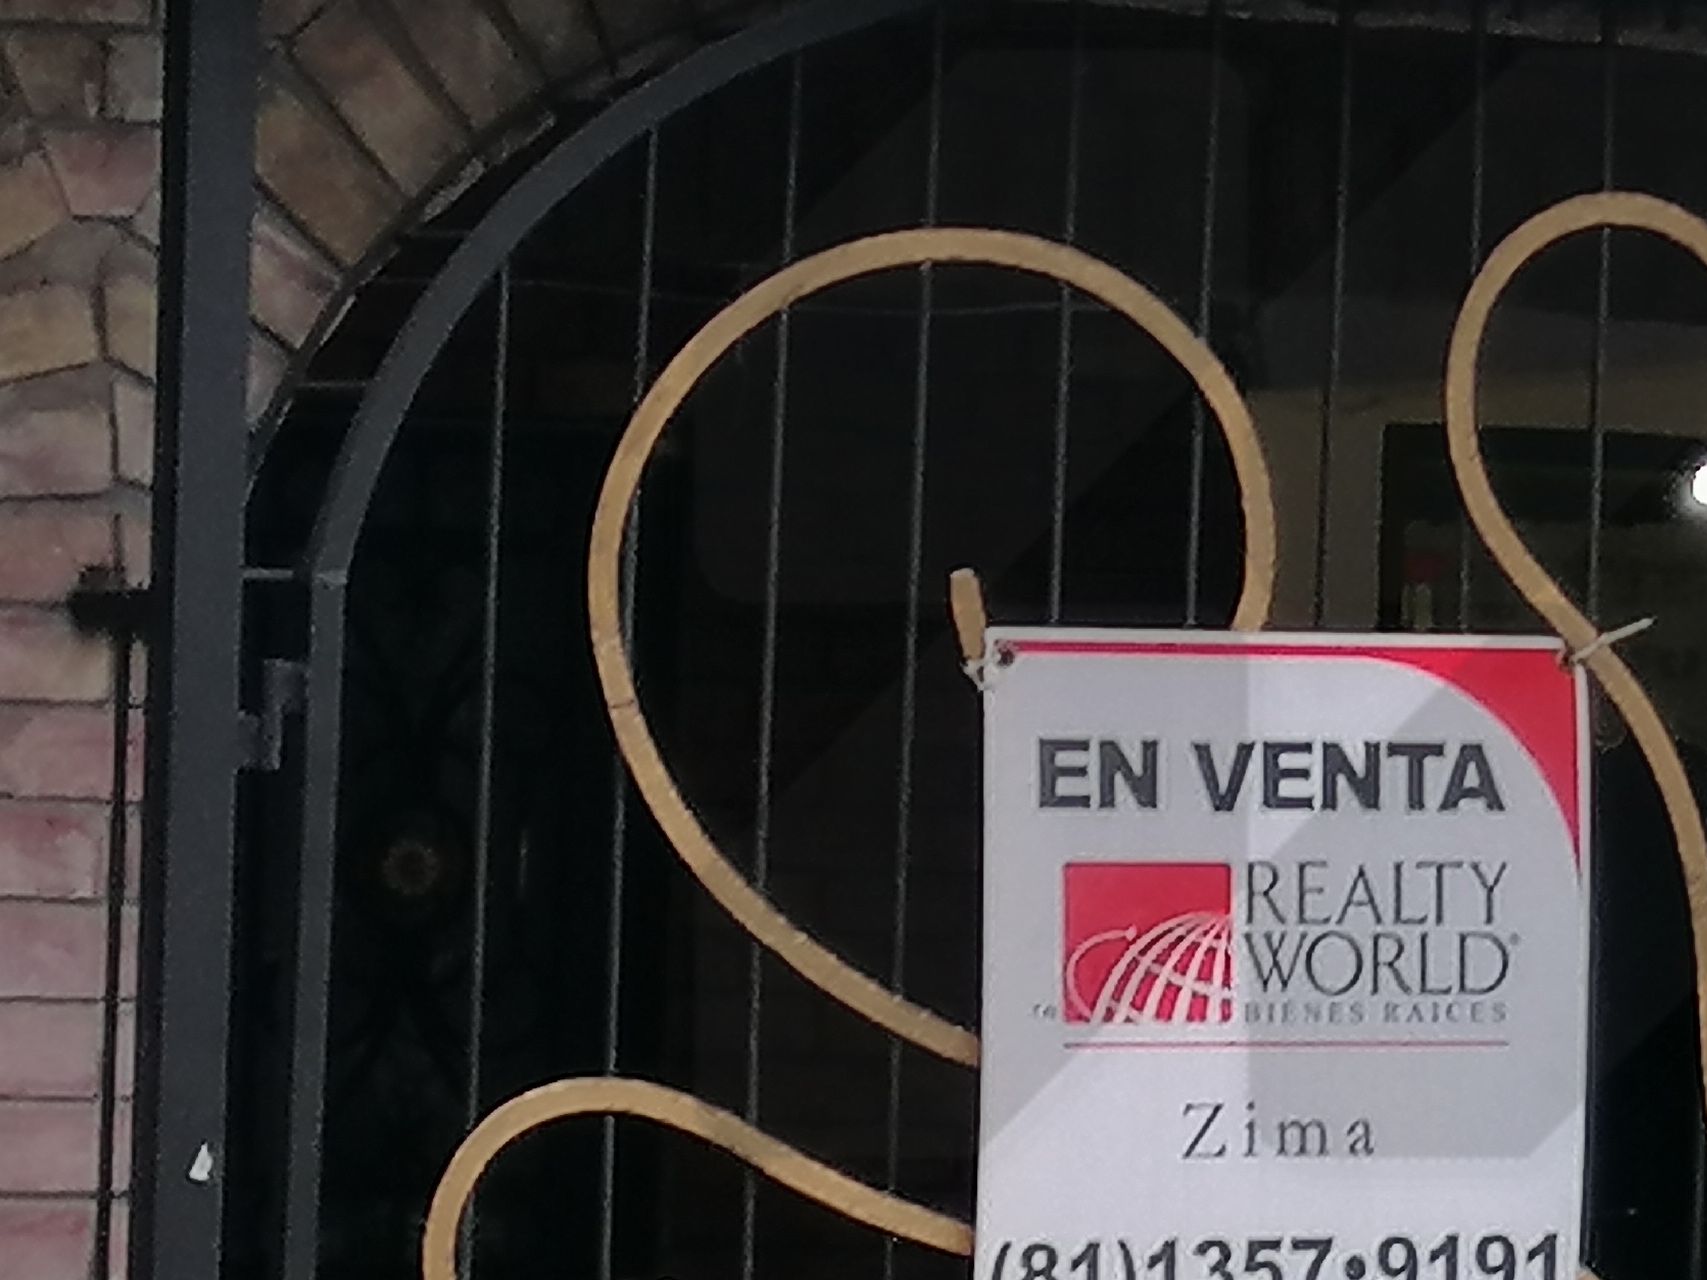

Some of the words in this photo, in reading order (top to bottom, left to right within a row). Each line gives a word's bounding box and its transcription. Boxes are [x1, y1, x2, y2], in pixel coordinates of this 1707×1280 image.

[1038, 738, 1158, 809] EN
[1191, 739, 1506, 812] VENTA
[1245, 860, 1508, 926] REALTY
[1243, 929, 1510, 996] WORLD
[1243, 1000, 1363, 1024] BIENES
[1180, 1100, 1375, 1160] Zima
